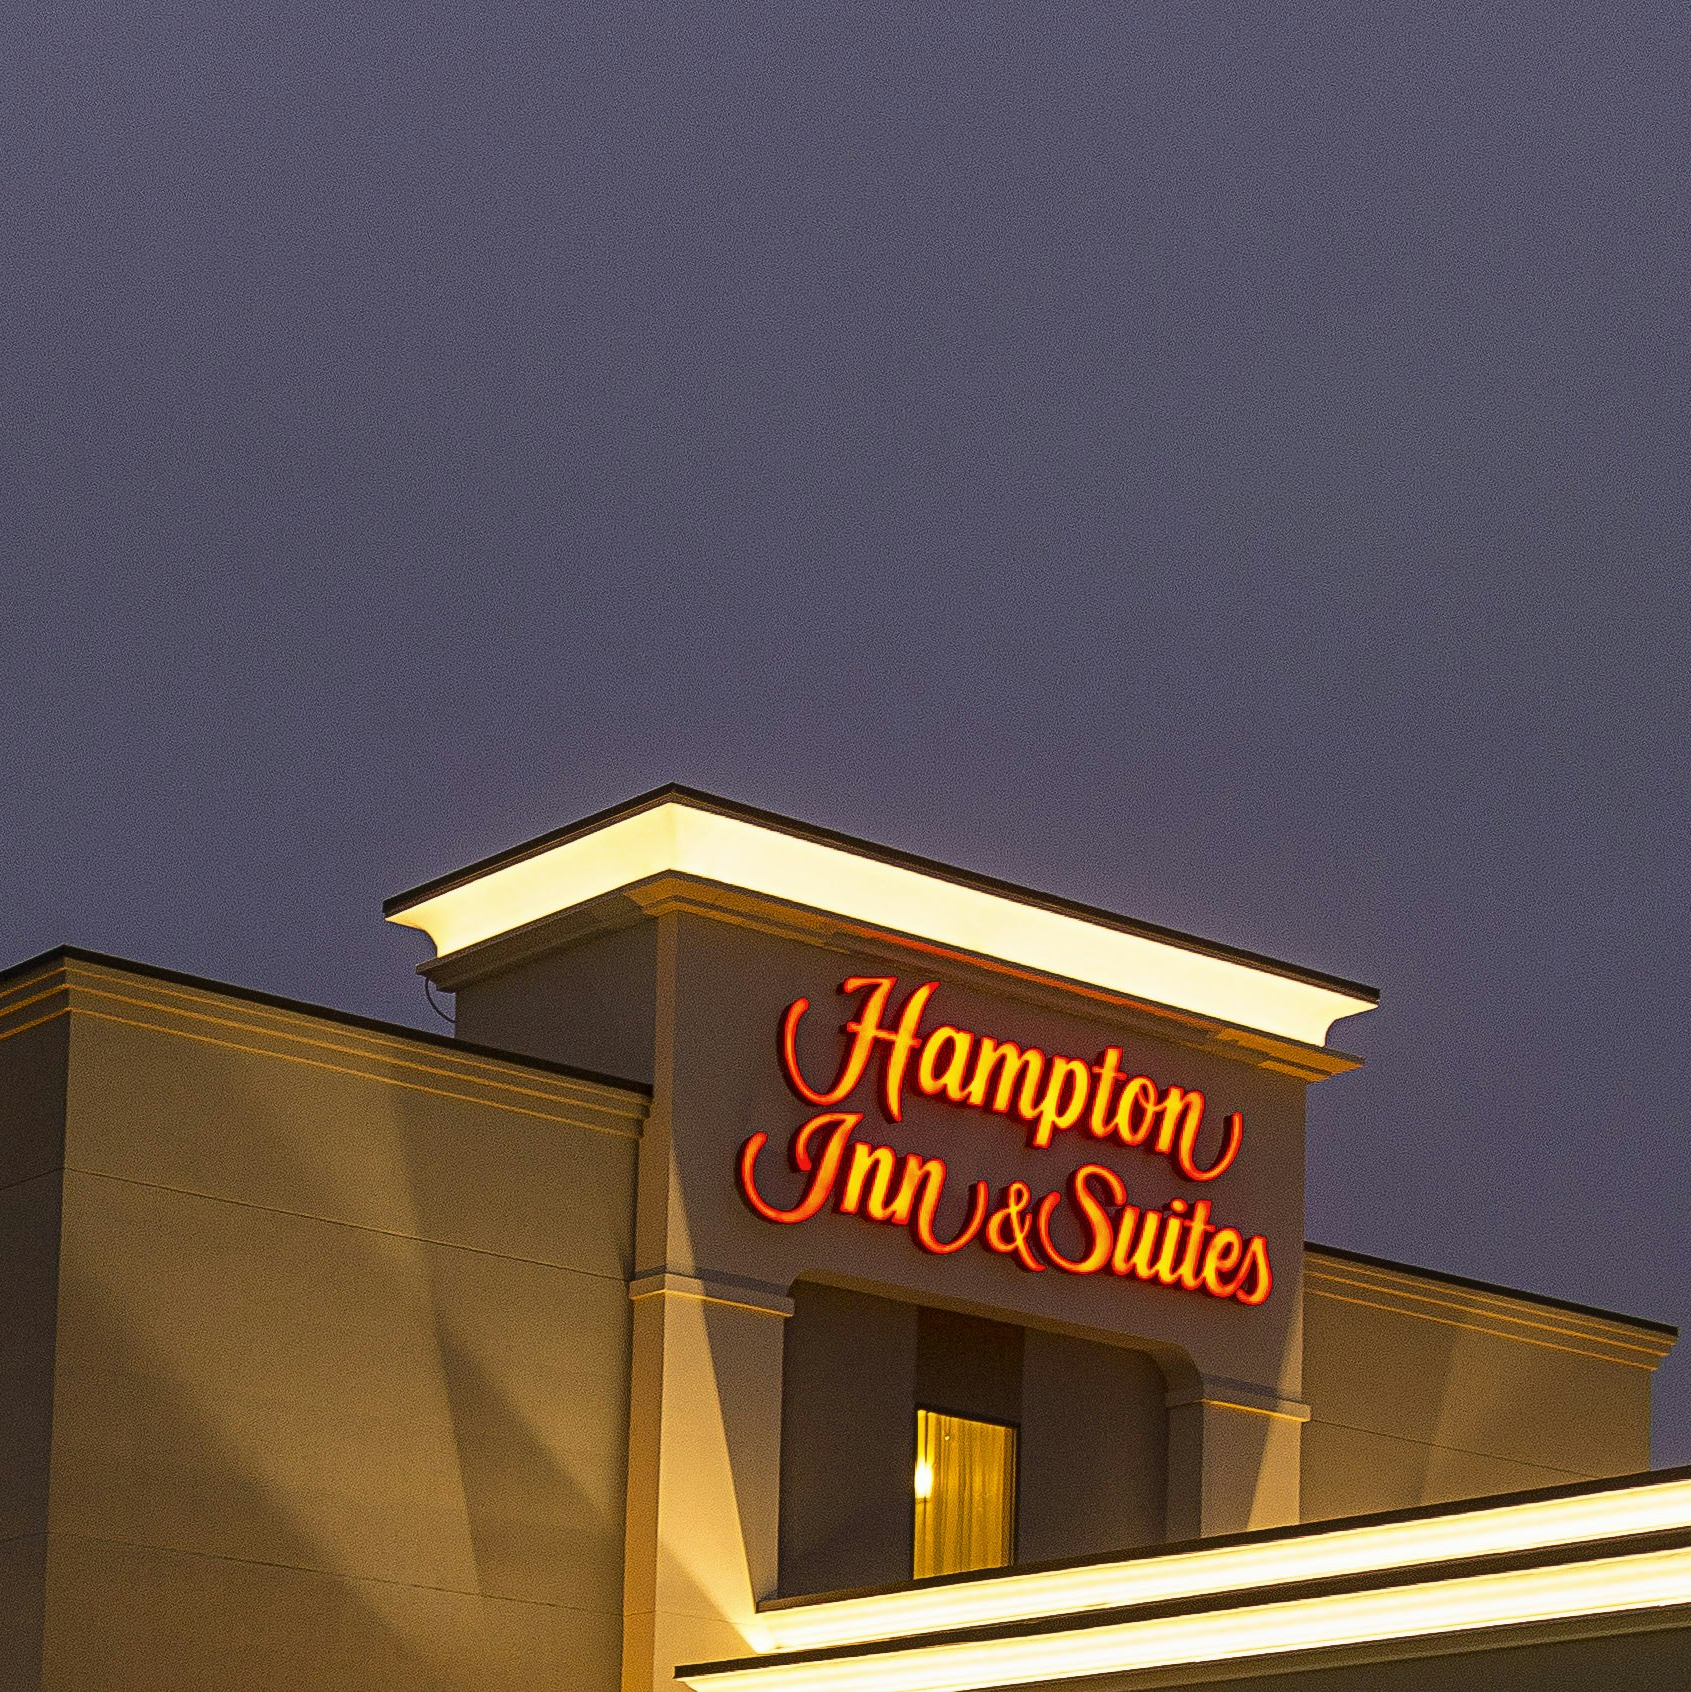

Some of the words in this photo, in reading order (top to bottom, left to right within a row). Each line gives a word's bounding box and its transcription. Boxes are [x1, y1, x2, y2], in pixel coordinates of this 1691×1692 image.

[778, 975, 1244, 1182] Hampton
[738, 1112, 988, 1255] Inn
[985, 1180, 1047, 1272] &
[1037, 1164, 1275, 1306] Suites
